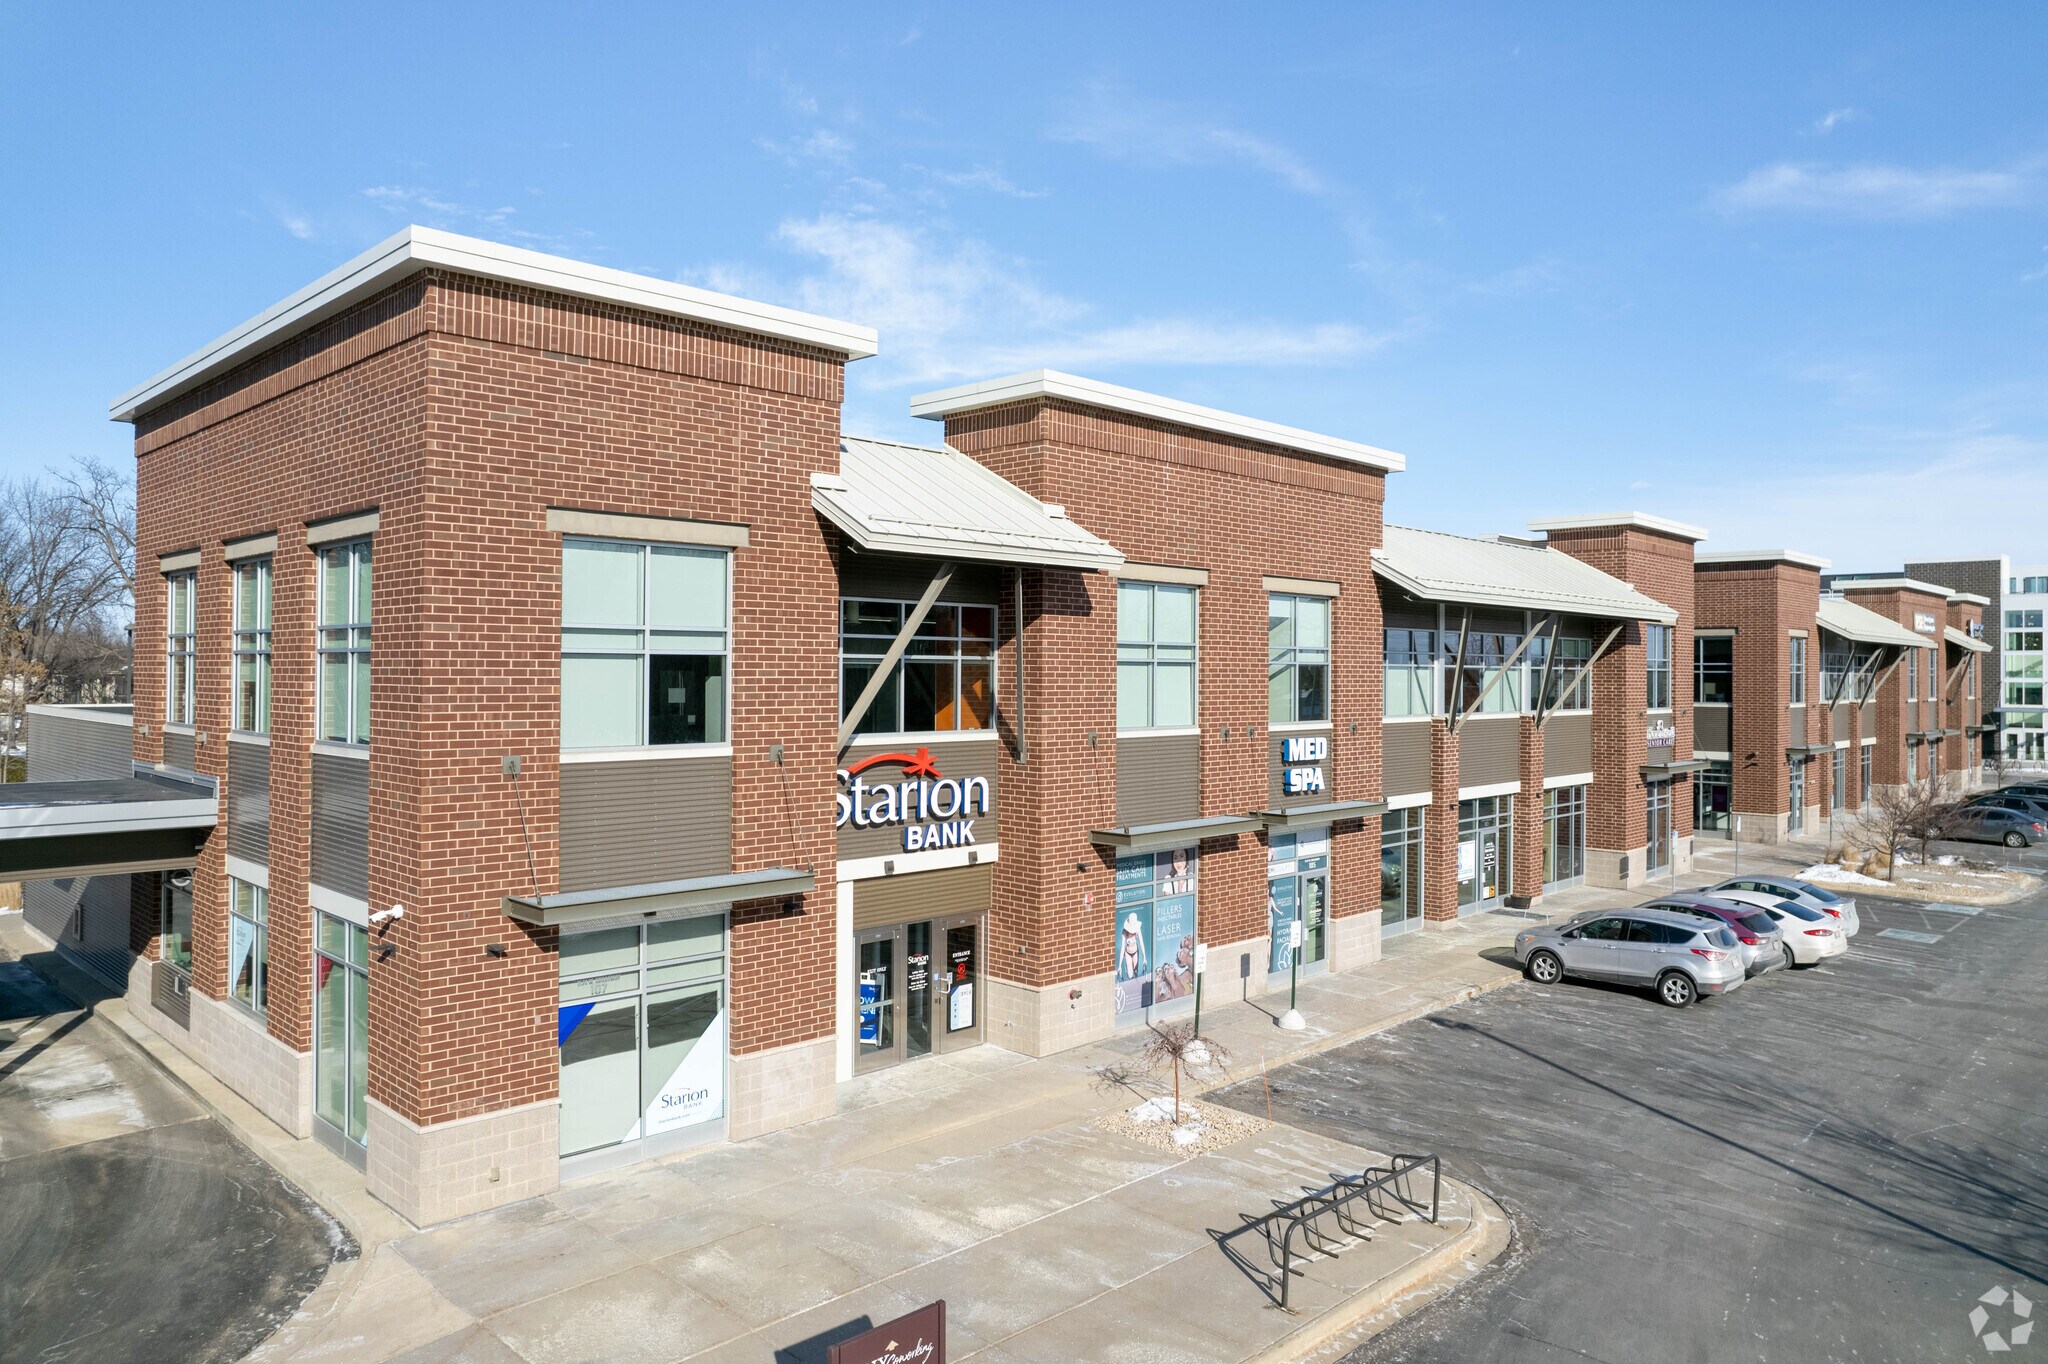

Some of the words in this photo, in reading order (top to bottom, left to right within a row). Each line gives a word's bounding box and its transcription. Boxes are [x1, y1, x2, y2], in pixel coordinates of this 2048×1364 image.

[1284, 737, 1327, 761] MED
[1285, 768, 1325, 791] SPA
[905, 820, 975, 850] BANK
[1116, 872, 1147, 881] TREATMENTS
[1123, 889, 1146, 898] EVOLUTION
[1157, 904, 1183, 916] FILLERS
[1157, 923, 1181, 936] LASER
[591, 983, 608, 995] 107
[661, 1088, 708, 1109] Starion
[683, 1101, 703, 1110] BANK
